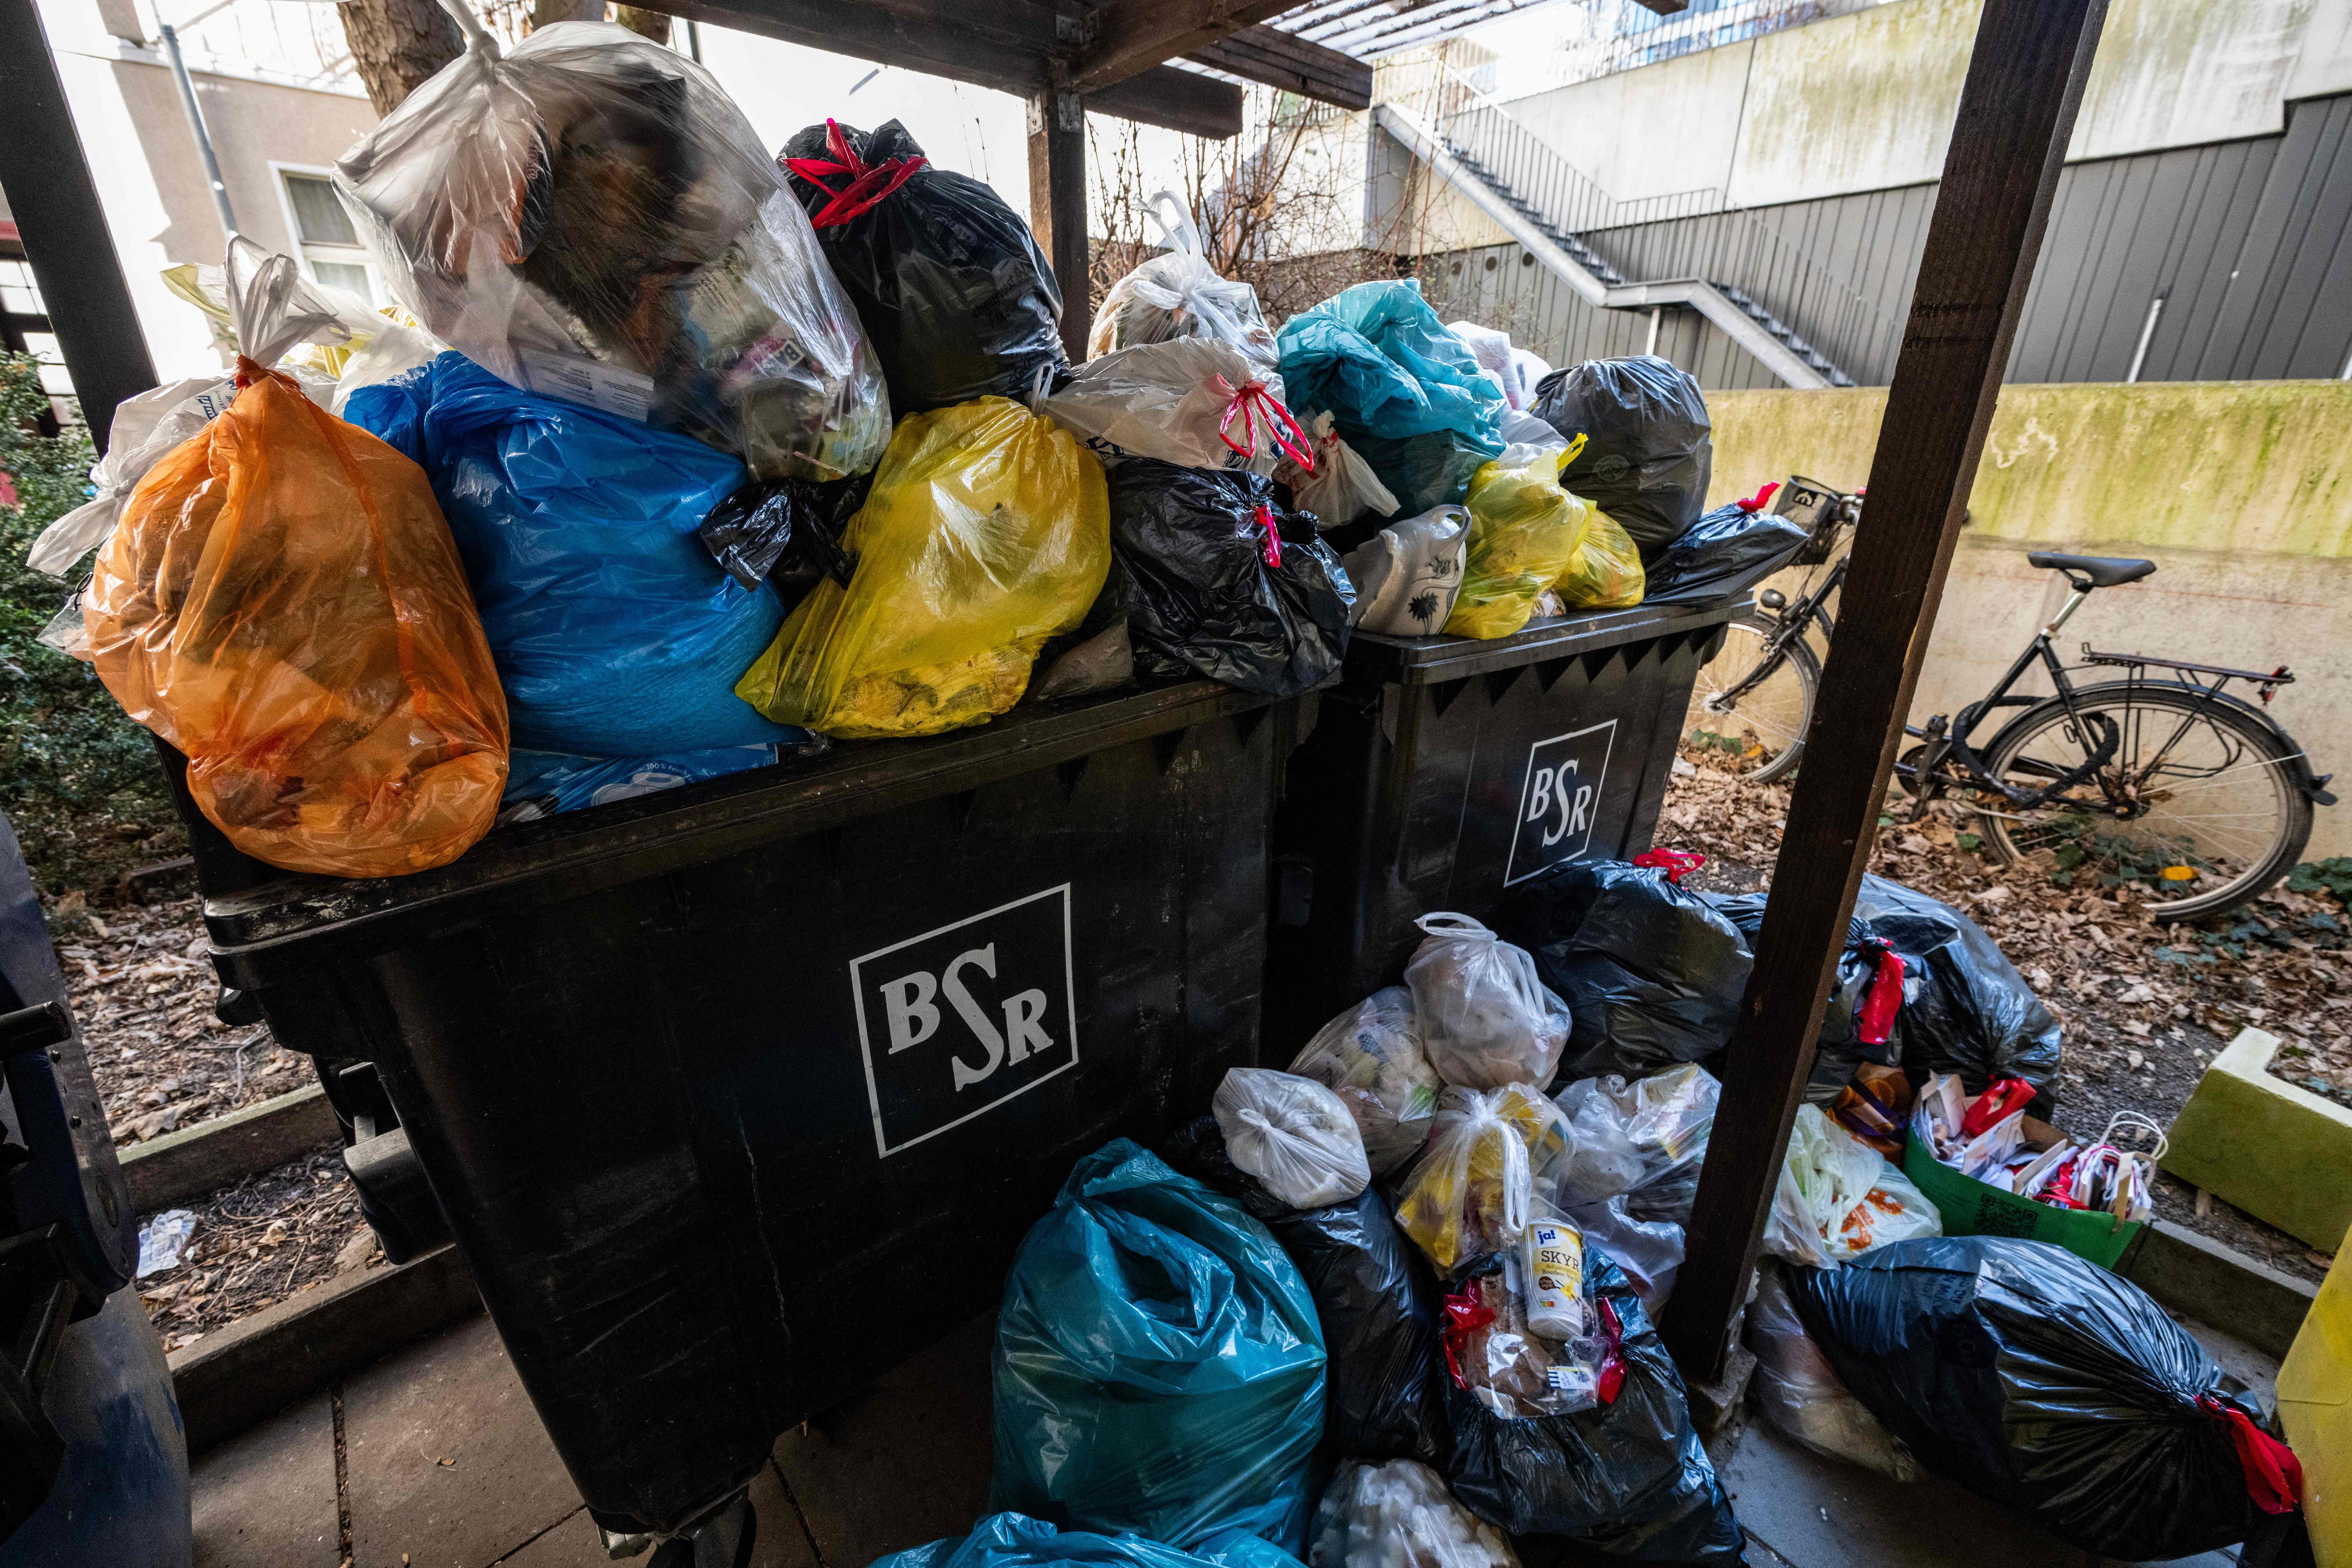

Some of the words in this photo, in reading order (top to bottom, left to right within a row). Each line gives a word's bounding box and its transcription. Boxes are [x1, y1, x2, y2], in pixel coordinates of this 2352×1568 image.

[196, 396, 216, 419] wirl
[1526, 758, 1592, 848] BSR
[880, 942, 1054, 1091] BSR
[1537, 1229, 1556, 1245] ja!
[1541, 1250, 1579, 1272] SKYR
